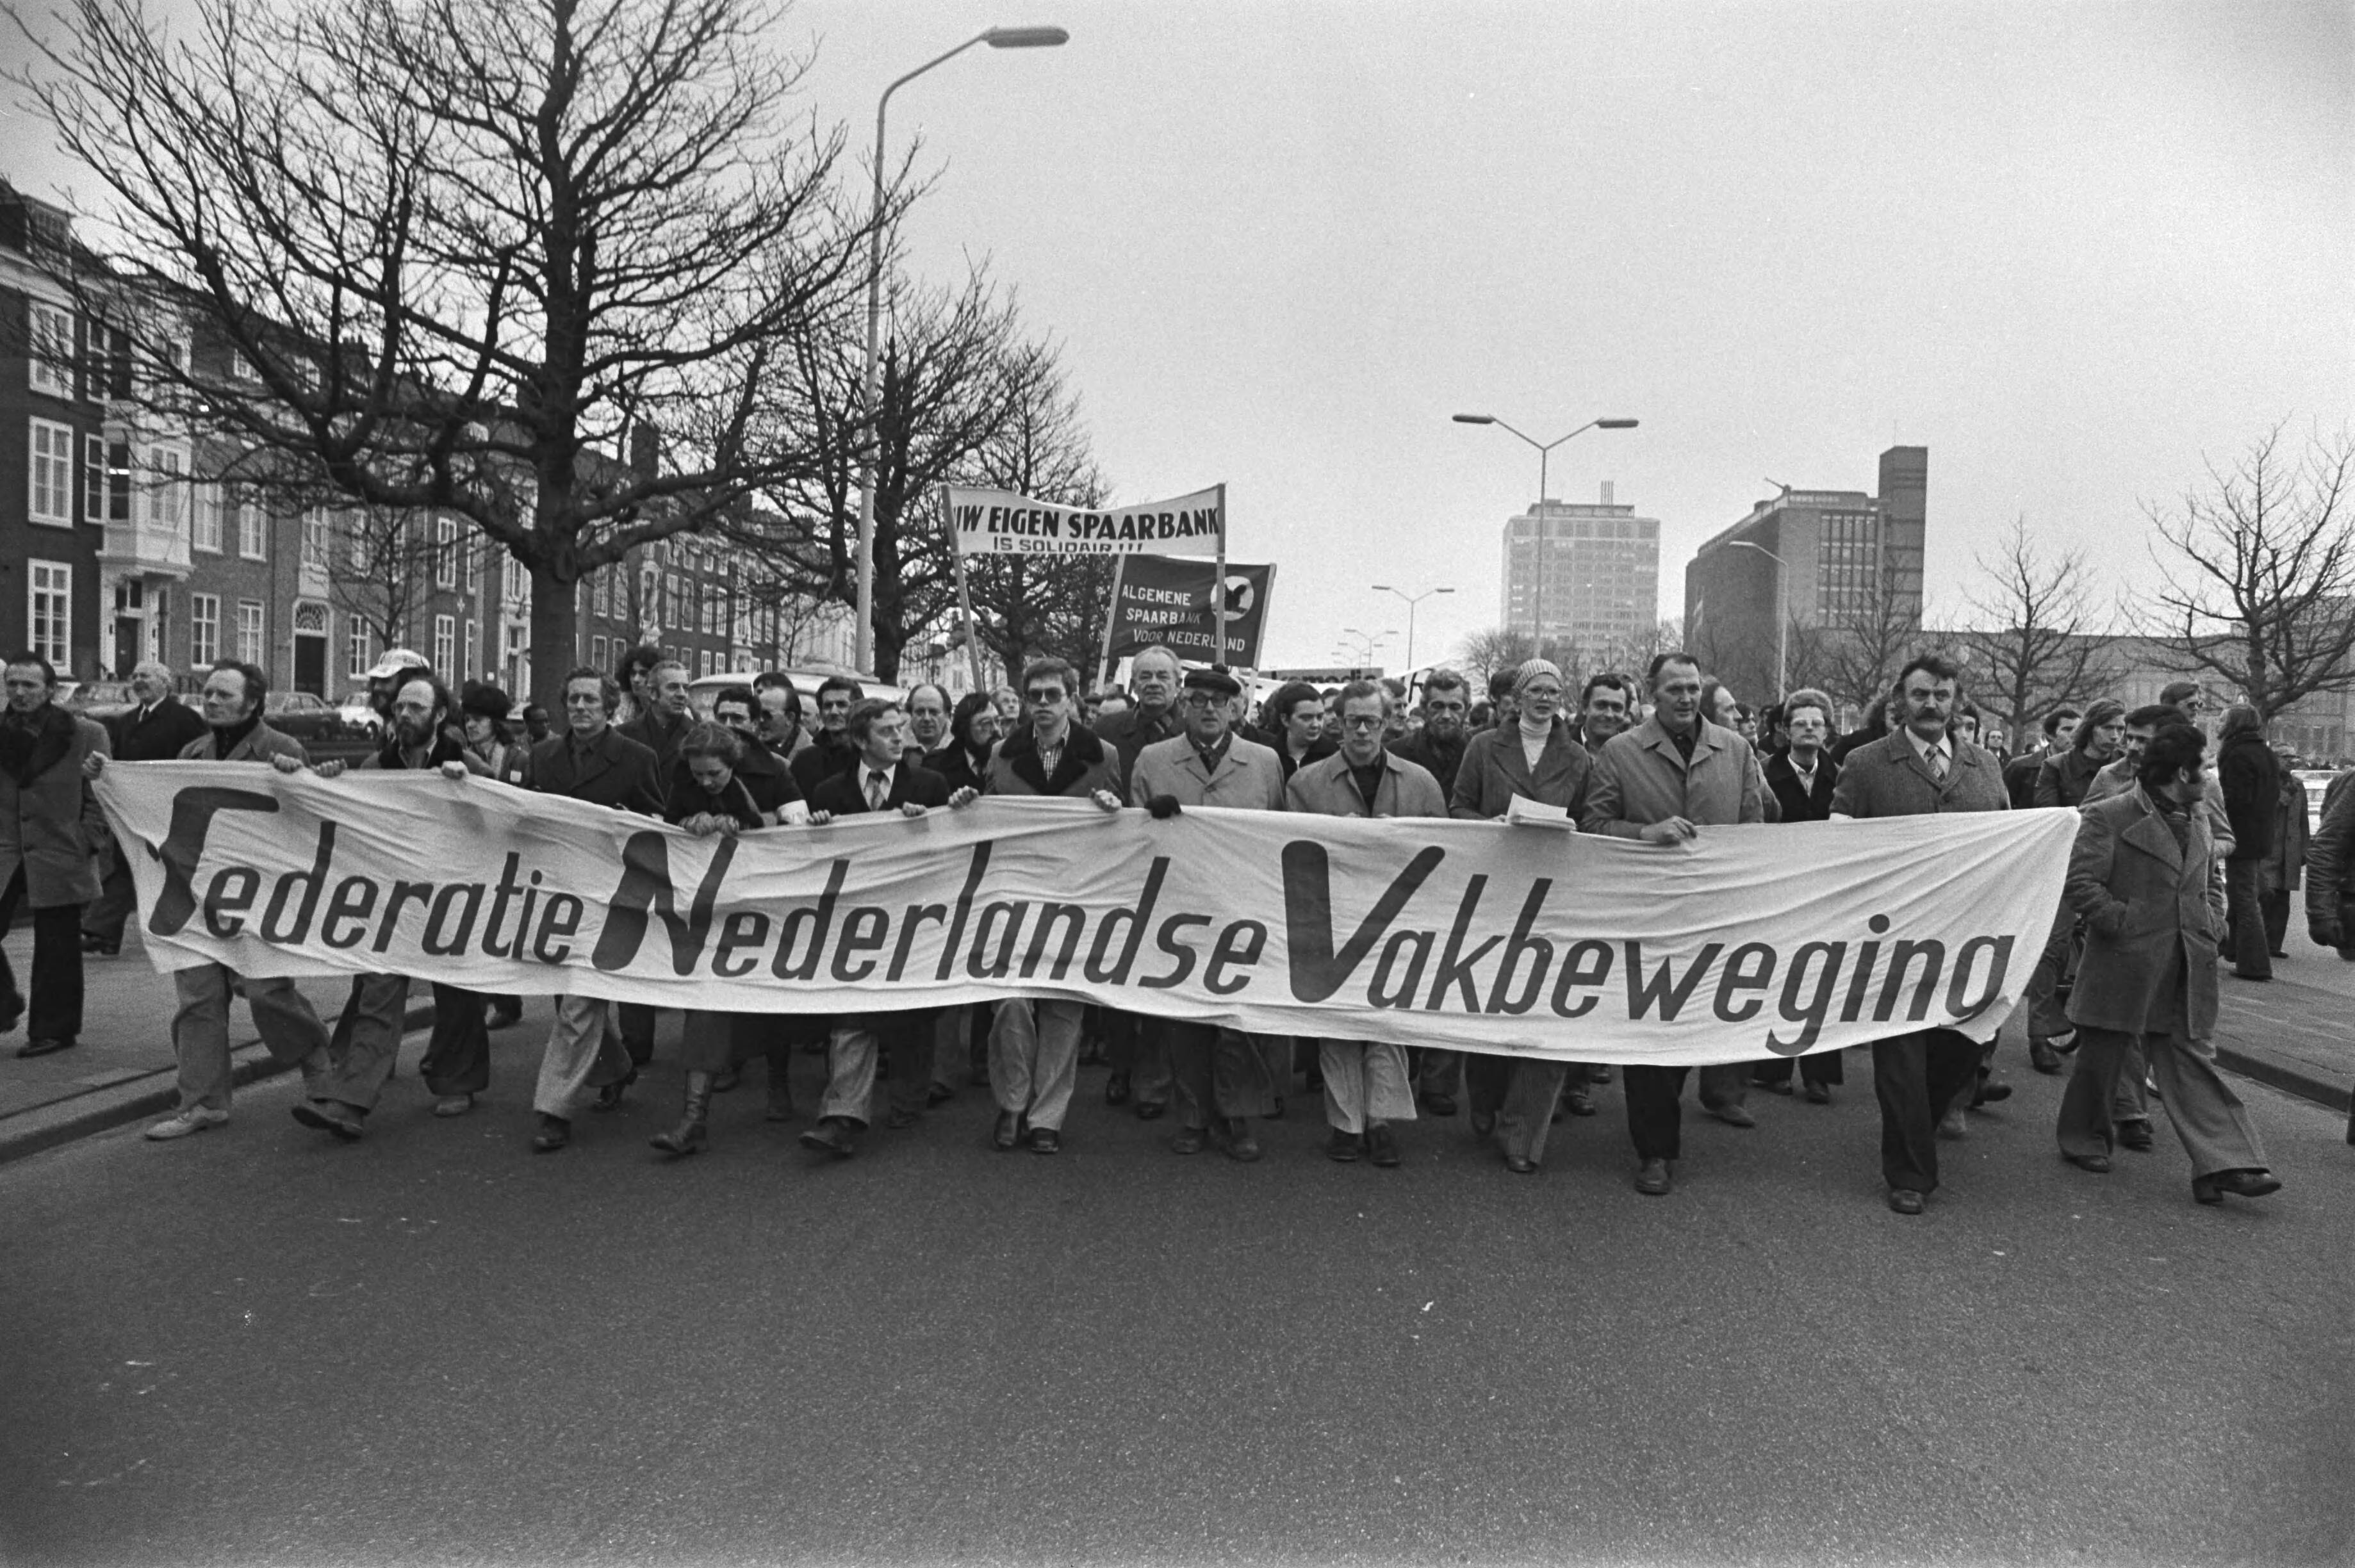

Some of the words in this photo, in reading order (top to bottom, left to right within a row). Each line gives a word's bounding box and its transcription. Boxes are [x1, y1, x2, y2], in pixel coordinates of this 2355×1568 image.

[953, 505, 985, 532] UW
[987, 507, 1060, 538] EIGEN
[1067, 507, 1219, 540] SPAARBANK
[993, 535, 1013, 551] IS
[1019, 539, 1113, 552] SOLIDAIR
[1122, 584, 1192, 607] ALGEMENE
[1126, 607, 1202, 625] SPAARBANK
[1133, 628, 1164, 643] VOOR
[147, 785, 585, 965] Federatie
[590, 830, 1268, 995] Nederlandse
